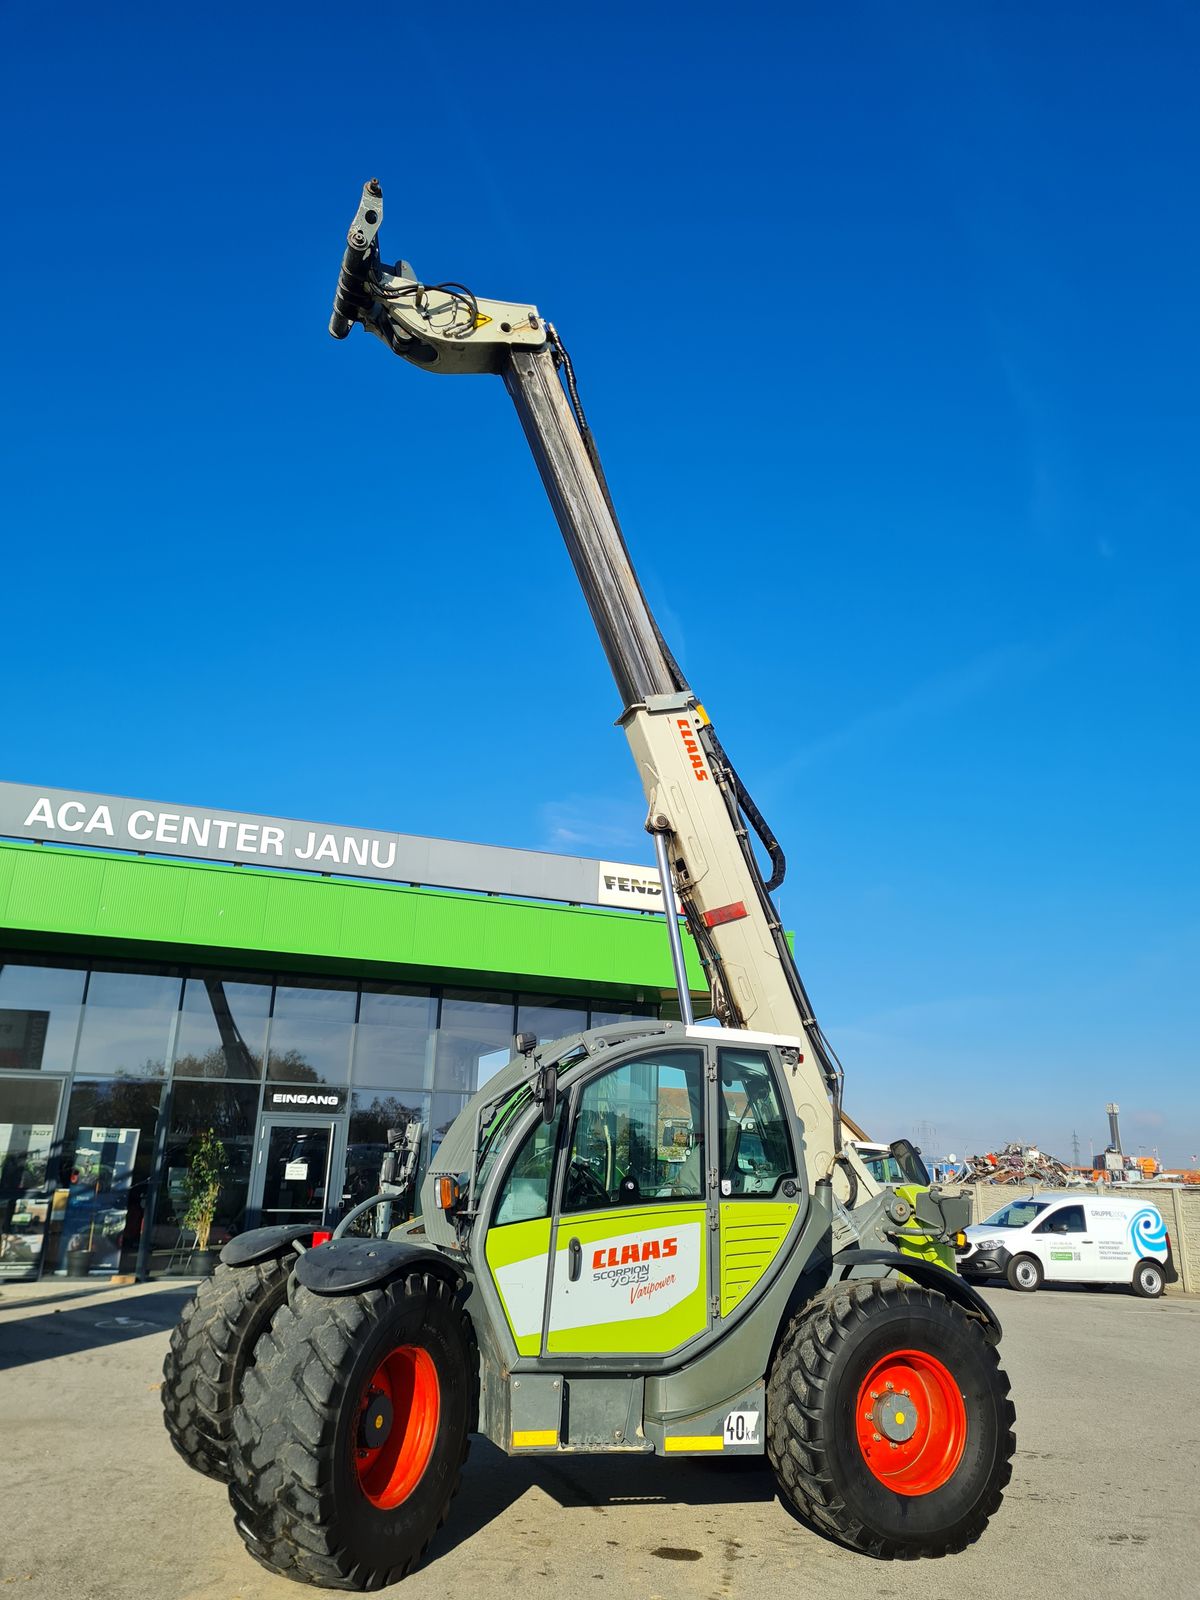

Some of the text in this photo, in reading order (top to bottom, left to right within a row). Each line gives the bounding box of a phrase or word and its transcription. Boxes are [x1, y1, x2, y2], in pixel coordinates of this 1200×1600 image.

[677, 719, 709, 781] CLAAS
[23, 797, 397, 869] ACA CENTER JANU
[603, 875, 662, 896] FEND
[272, 1093, 339, 1106] EINGANG
[592, 1237, 678, 1270] CLAAS
[593, 1264, 650, 1281] SCORPION
[611, 1271, 649, 1287] 7045
[630, 1274, 676, 1304] Varipower
[726, 1415, 745, 1441] 40
